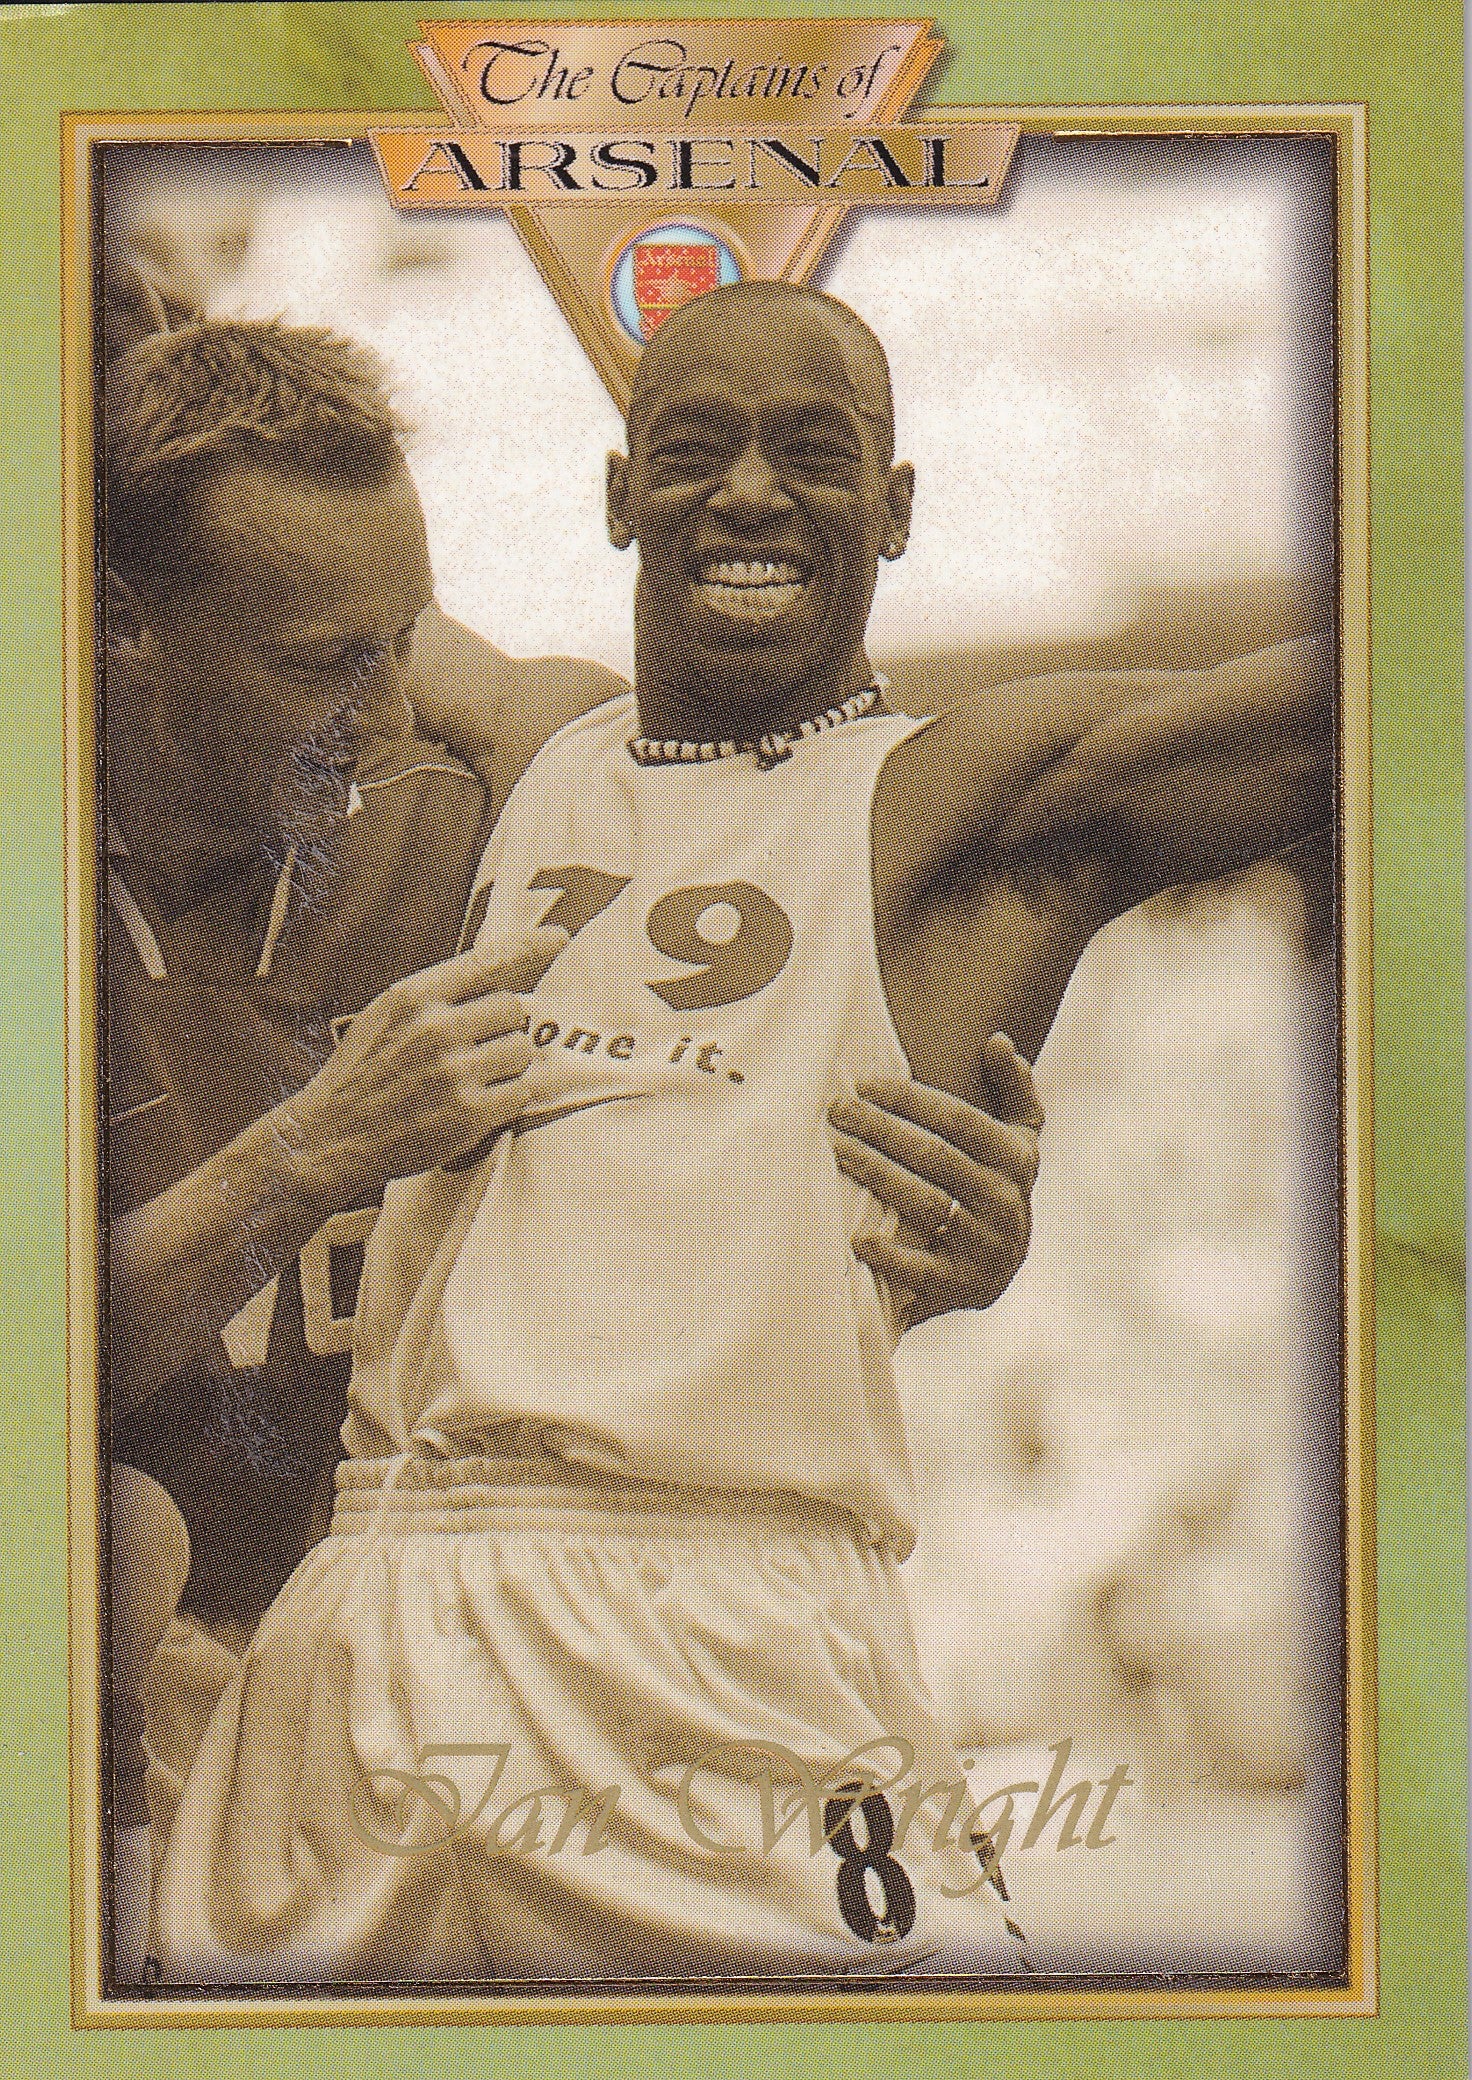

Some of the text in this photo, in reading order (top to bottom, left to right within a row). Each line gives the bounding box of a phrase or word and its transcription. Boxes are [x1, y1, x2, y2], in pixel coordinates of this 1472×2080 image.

[462, 38, 900, 119] The Captains of
[401, 137, 991, 192] ARSENAL
[521, 1015, 745, 1084] one it.
[347, 1736, 1136, 1898] Ian Wright
[823, 1777, 917, 1945] 8
